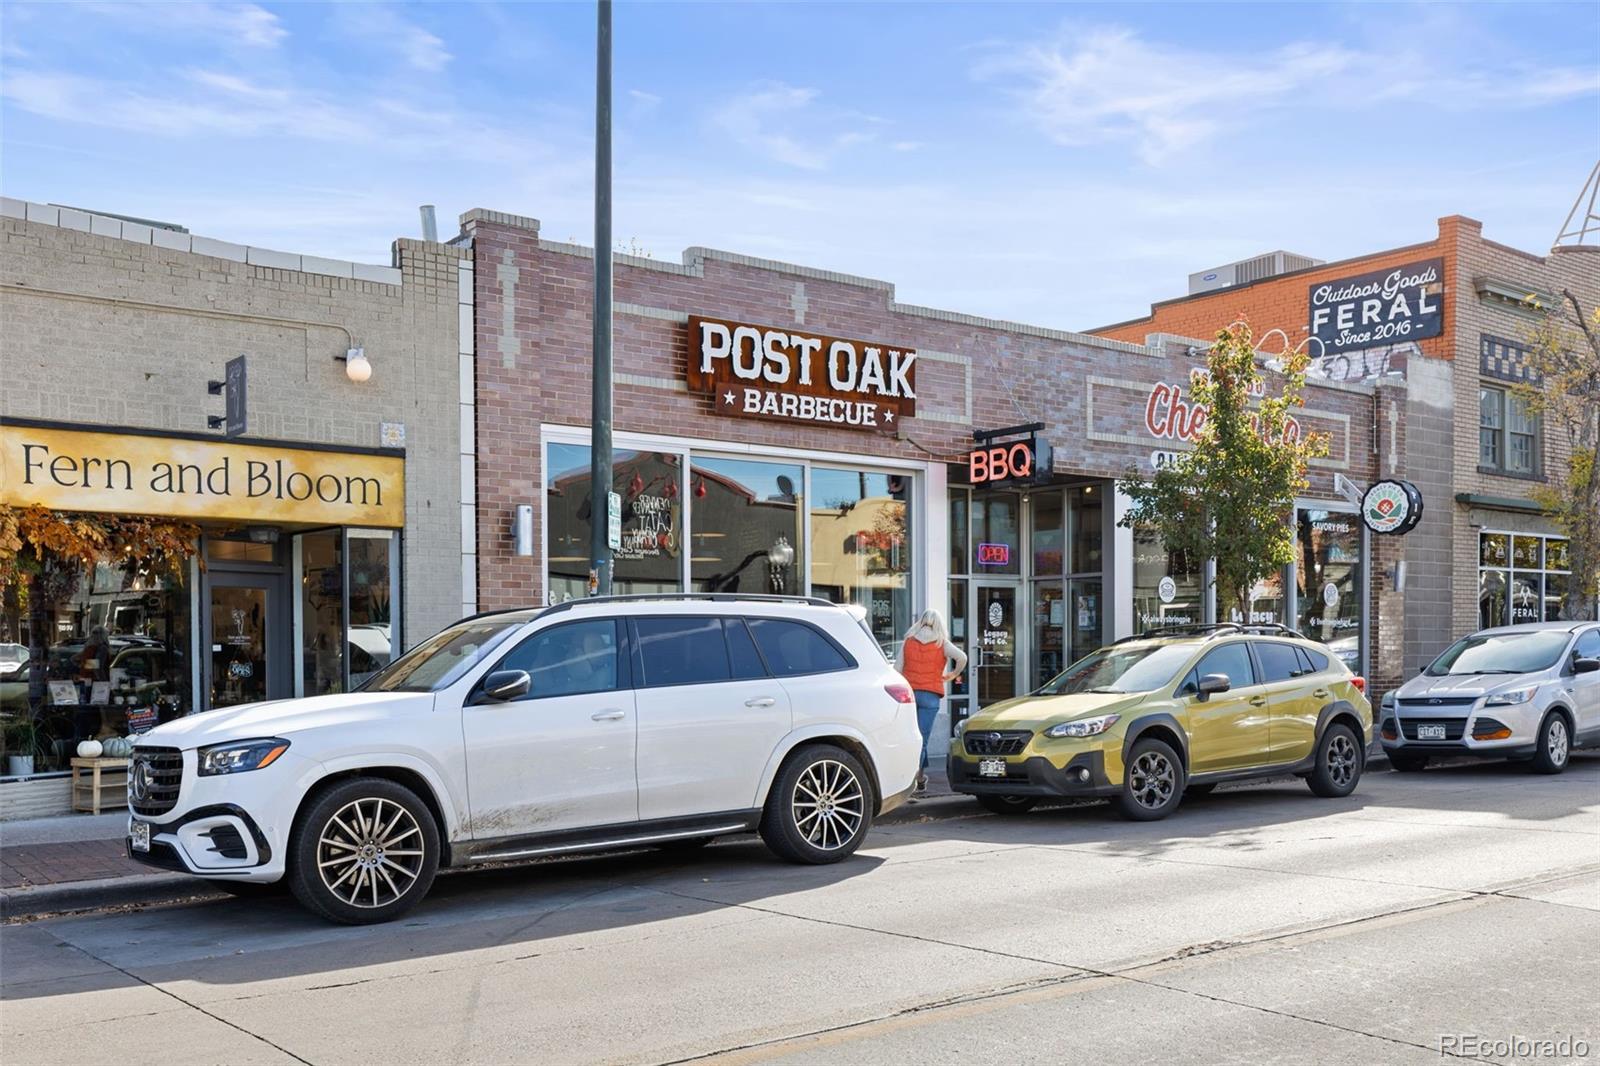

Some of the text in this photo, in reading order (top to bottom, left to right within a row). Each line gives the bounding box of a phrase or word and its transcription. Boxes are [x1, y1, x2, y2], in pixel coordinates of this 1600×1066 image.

[1313, 266, 1437, 305] Outdoor Goods
[1313, 288, 1437, 334] FERAL
[1335, 320, 1411, 346] Since 2016
[700, 321, 917, 399] POST OAK
[743, 388, 878, 426] BARBECUE
[22, 444, 382, 505] Fern and Bloom
[970, 443, 1031, 483] BBQ
[1312, 521, 1350, 533] SAVORY PIES
[980, 545, 1009, 562] OPEN
[1513, 608, 1538, 618] FERAL
